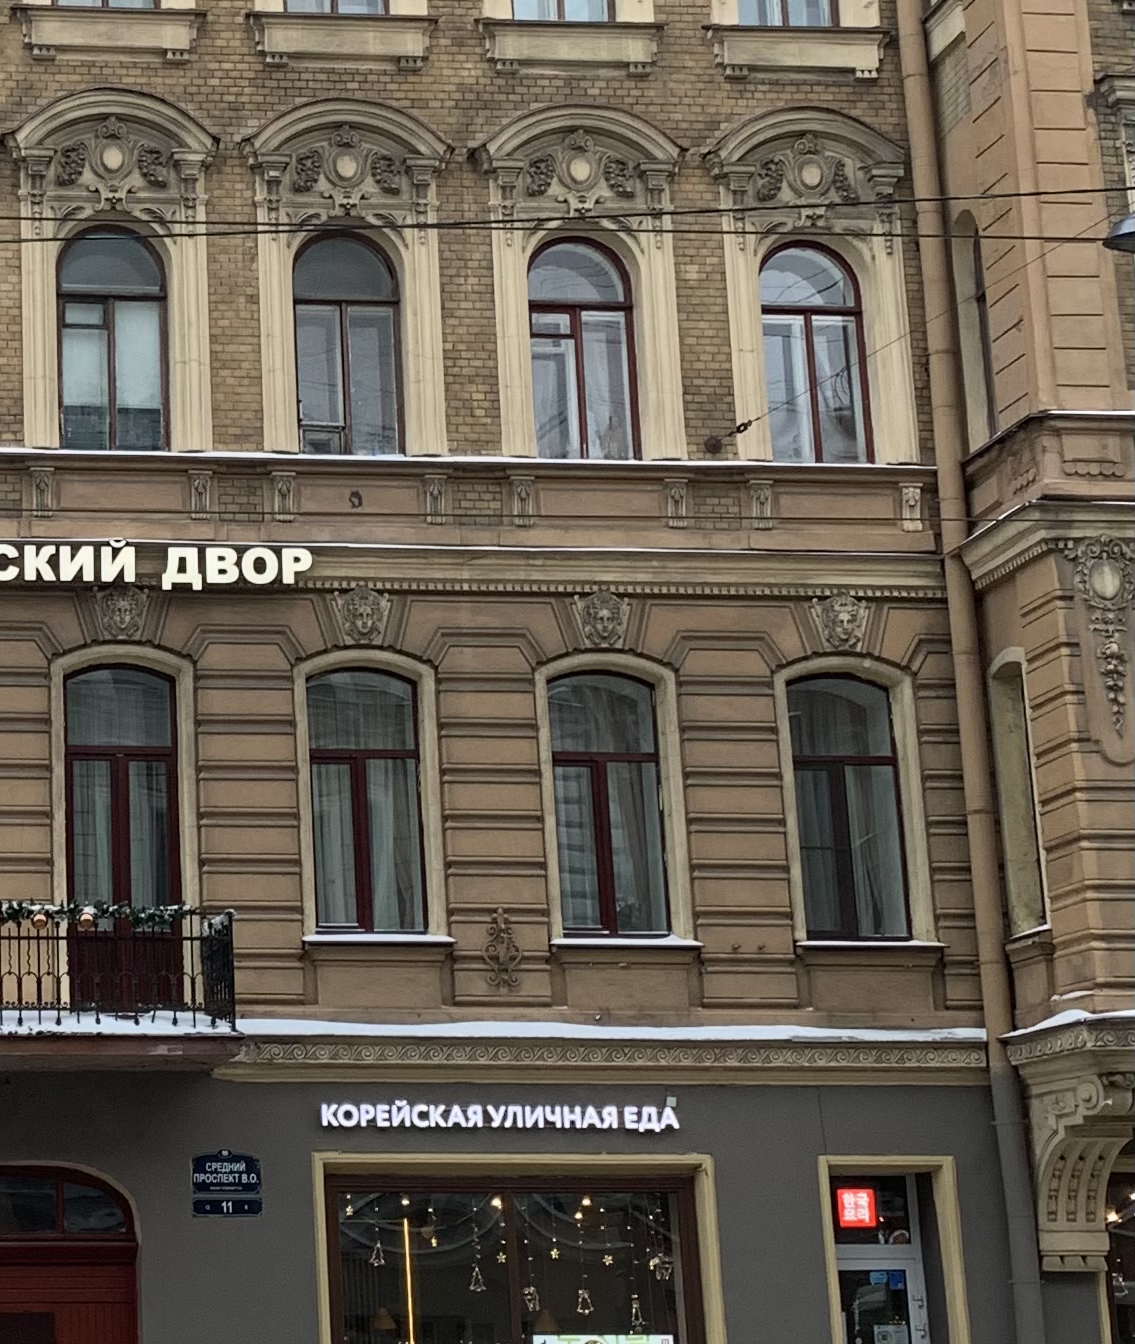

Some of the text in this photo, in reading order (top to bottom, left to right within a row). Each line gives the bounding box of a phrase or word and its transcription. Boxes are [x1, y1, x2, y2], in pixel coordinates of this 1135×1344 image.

[161, 546, 314, 591] ДВОР
[320, 1099, 680, 1133] КОРЕЙСКАЯ УЛИЧНАЯ ЕДА
[206, 1161, 245, 1172] СРЕДНИЙ
[193, 1173, 259, 1184] ПРОСПЕКТ В.О.
[221, 1201, 233, 1214] 11
